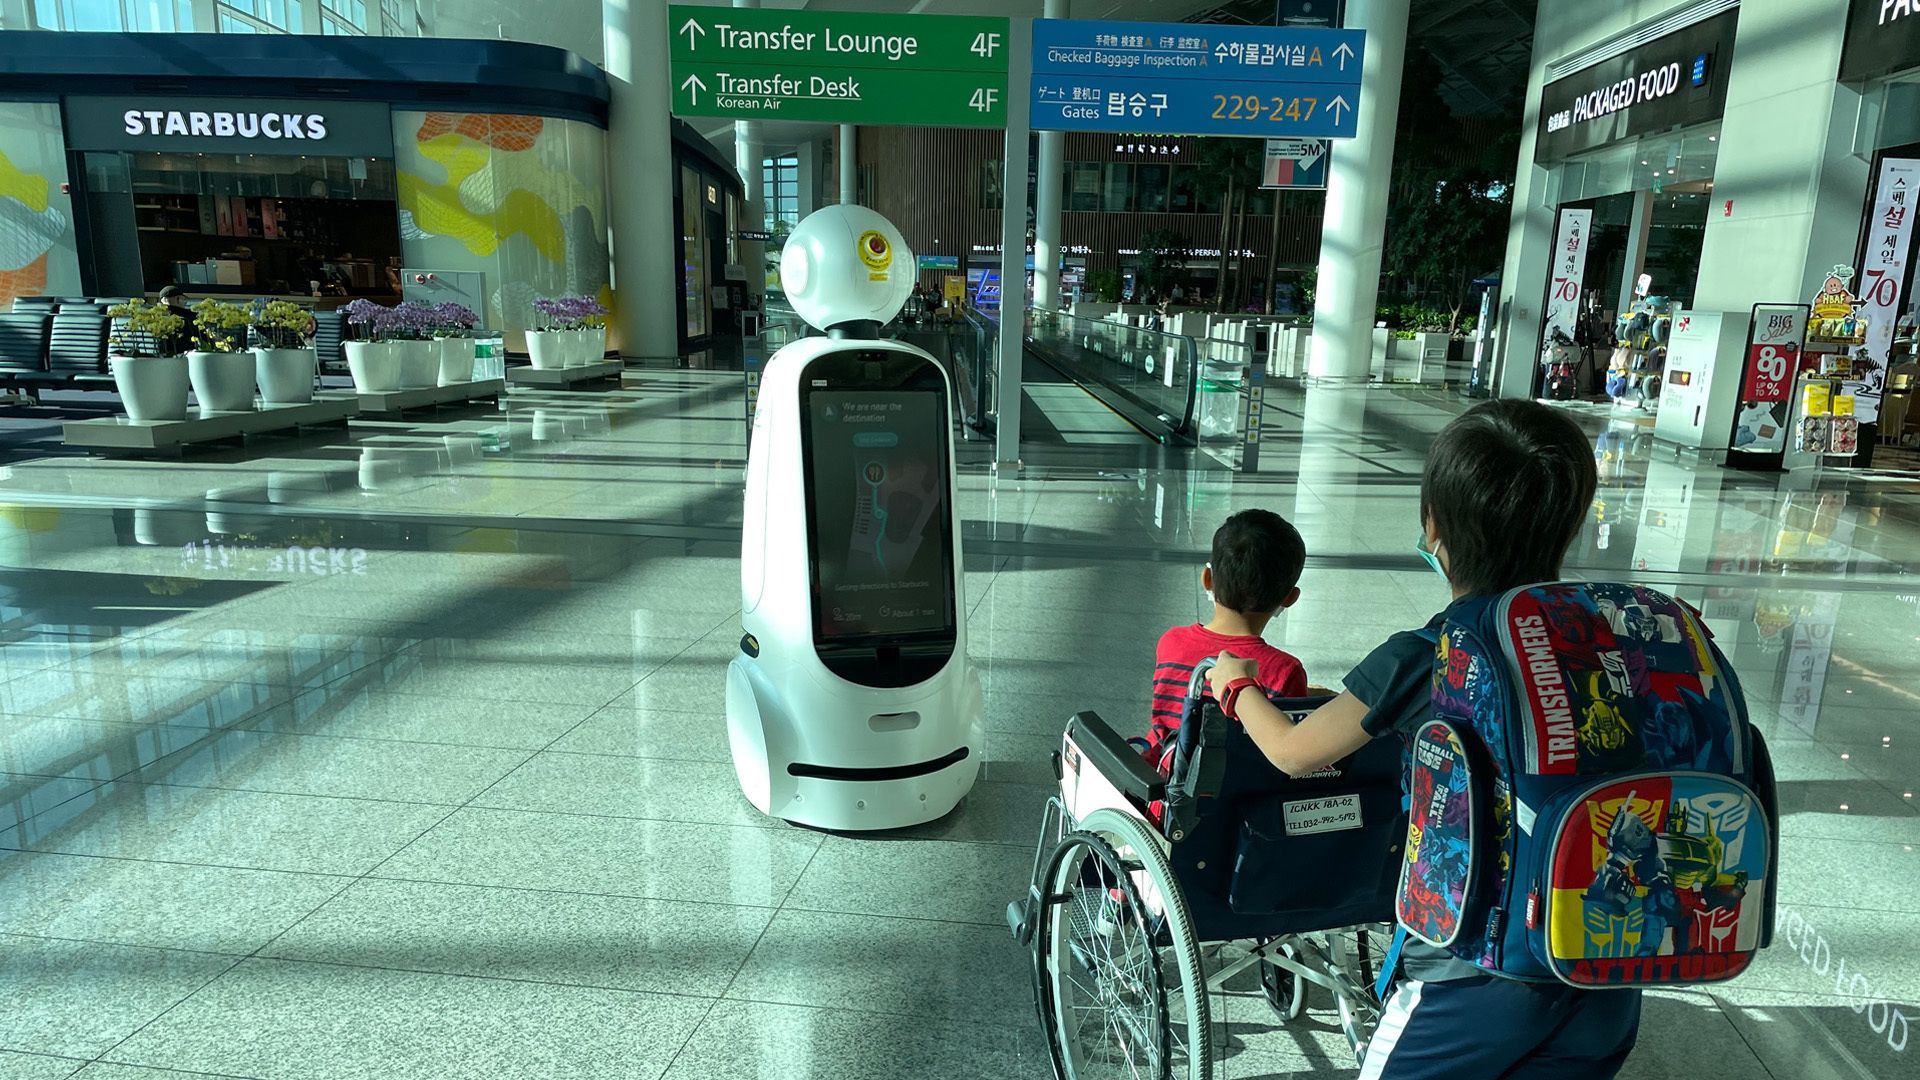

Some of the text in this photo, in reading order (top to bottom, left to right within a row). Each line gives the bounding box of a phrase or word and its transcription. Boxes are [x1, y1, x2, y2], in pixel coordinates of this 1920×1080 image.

[714, 24, 918, 61] Transfer Lounge
[970, 32, 1001, 58] 4F
[1048, 50, 1208, 68] Checked Baggage Inspection A
[716, 73, 860, 98] Transfer Desk
[1038, 86, 1066, 99] ゲート
[1072, 87, 1101, 100] 登机口
[1572, 62, 1680, 123] PACKAGED FOOD
[716, 96, 781, 110] Korean Air
[968, 88, 999, 113] 4F
[1062, 105, 1100, 119] Gates
[1107, 92, 1168, 118] 탑승구
[1211, 94, 1318, 122] 229-247
[124, 109, 327, 141] STARBUCKS
[1300, 144, 1320, 156] 5M
[1554, 277, 1579, 302] 70
[1866, 269, 1898, 307] 70
[1769, 315, 1793, 328] BIG
[1757, 346, 1787, 382] 80
[843, 413, 886, 423] destination
[856, 403, 869, 411] are
[870, 403, 887, 411] near
[889, 402, 902, 411] the
[1514, 615, 1576, 765] TRANSFORMERS
[1430, 744, 1454, 761] SHALL
